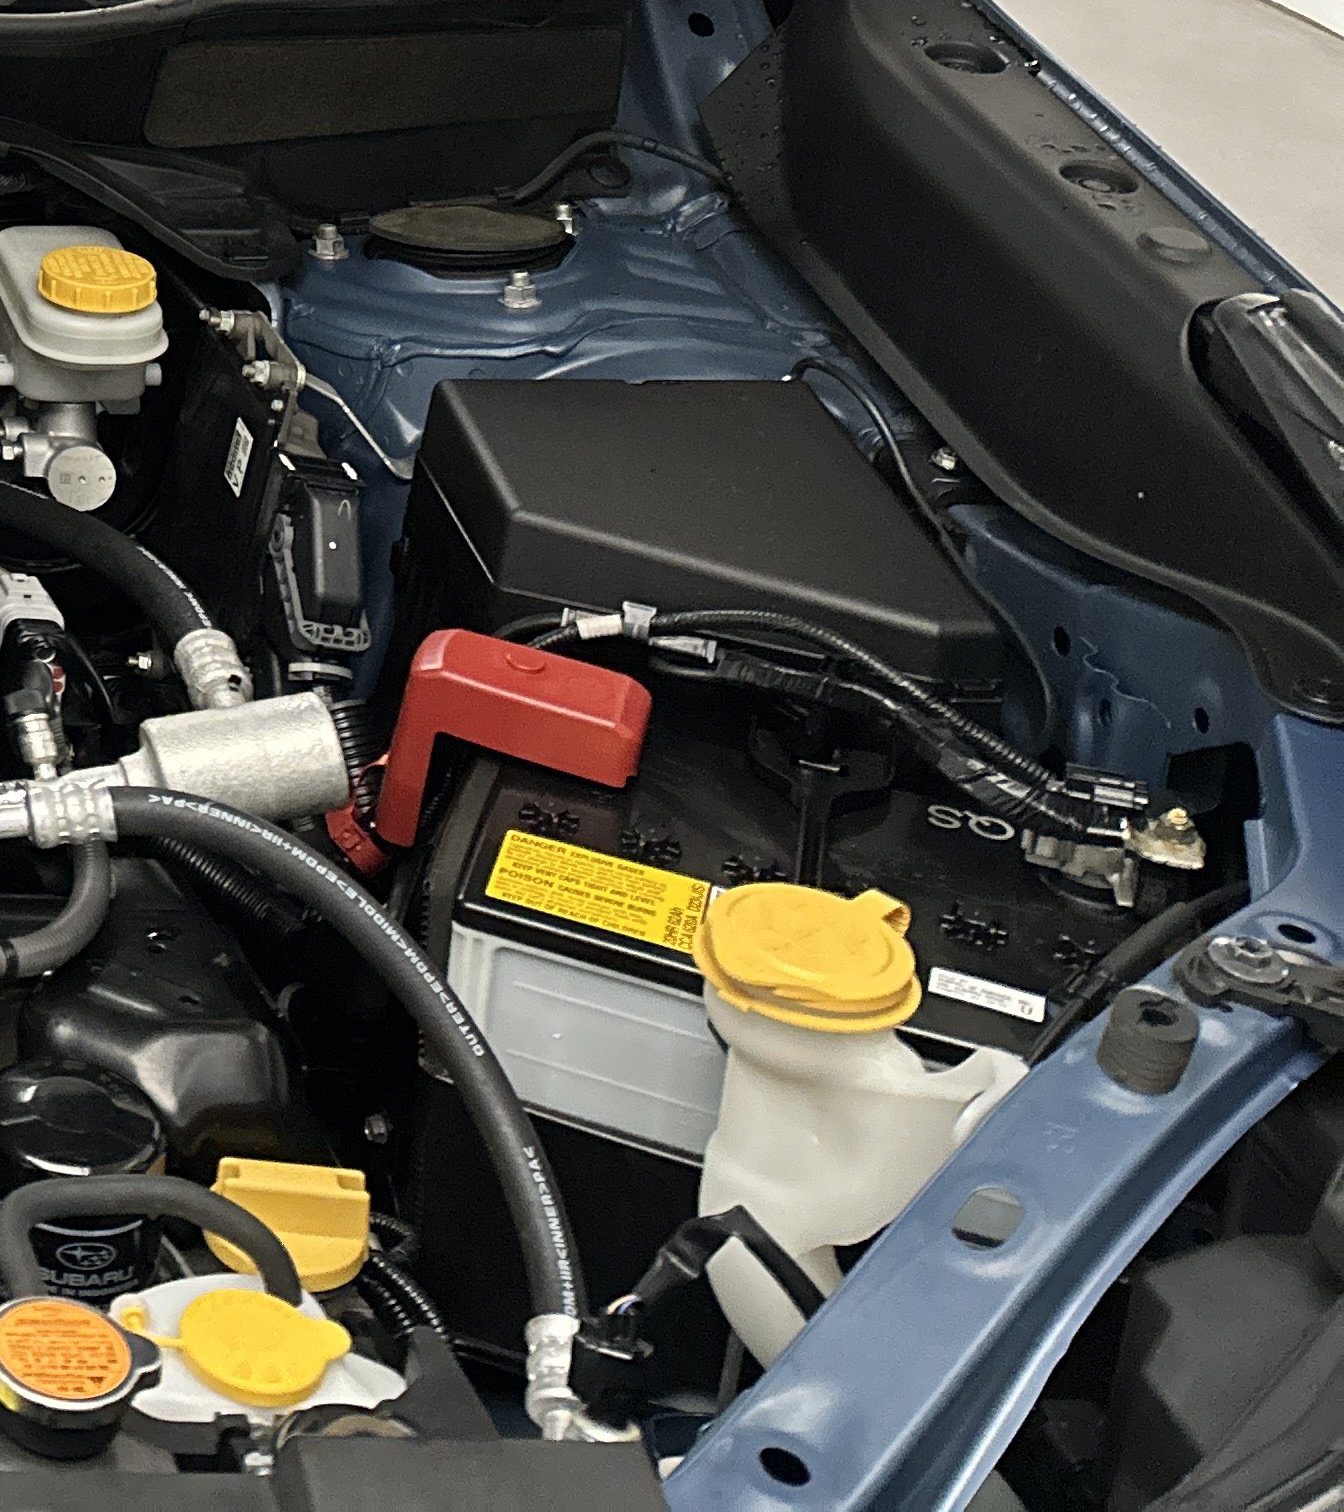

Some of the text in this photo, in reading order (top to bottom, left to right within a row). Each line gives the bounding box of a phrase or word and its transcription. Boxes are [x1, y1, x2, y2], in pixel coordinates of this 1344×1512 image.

[510, 833, 566, 855] DANGER
[498, 866, 554, 888] POISON
[37, 1265, 136, 1287] SUBARU
